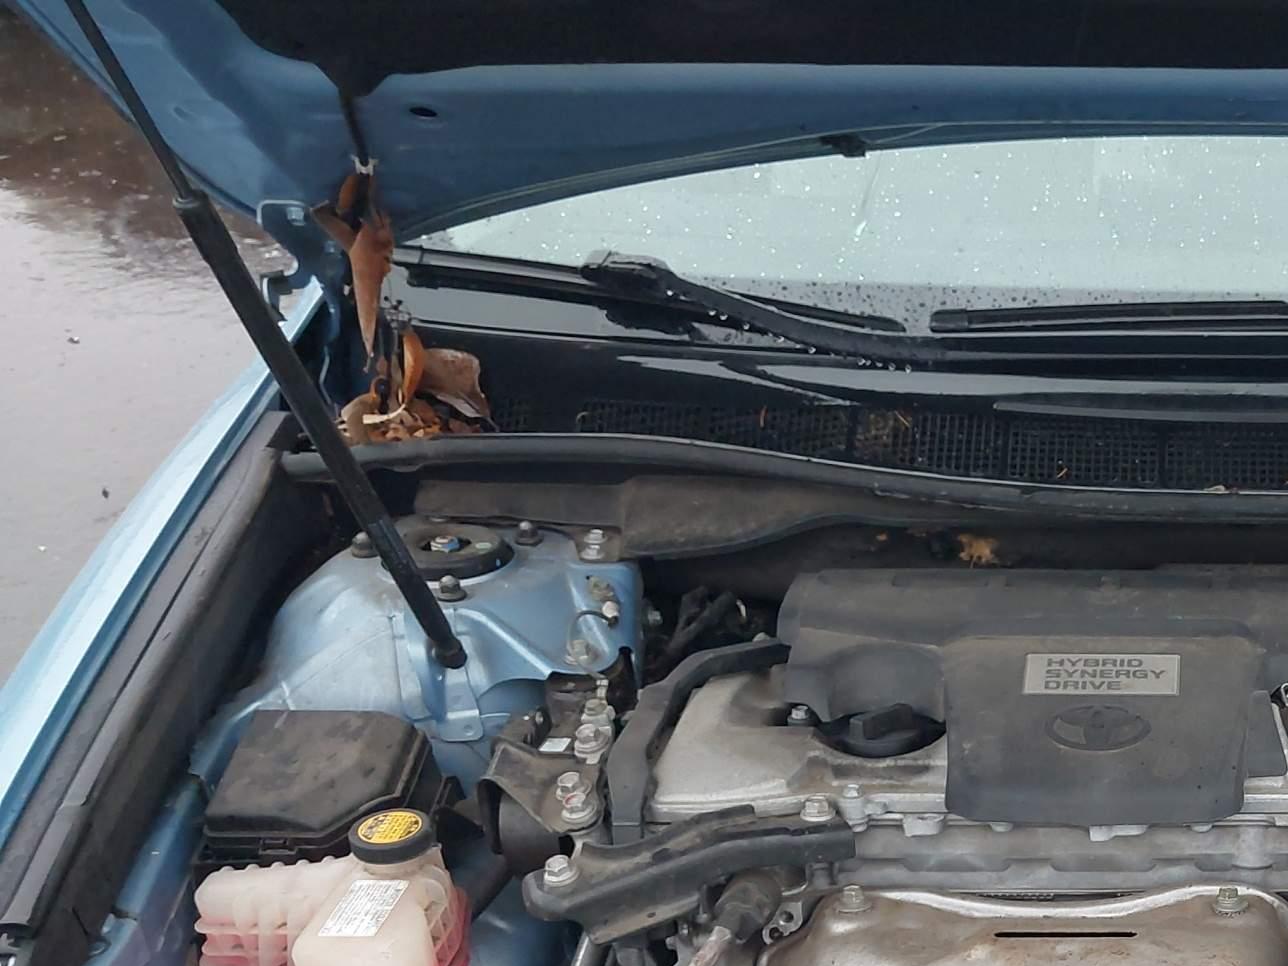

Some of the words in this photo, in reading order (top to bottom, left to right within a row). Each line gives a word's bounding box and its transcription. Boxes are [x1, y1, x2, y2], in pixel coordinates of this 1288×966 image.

[1047, 658, 1143, 668] HYBRID
[1045, 669, 1166, 679] SYNERGY
[1043, 680, 1123, 690] DRIVE
